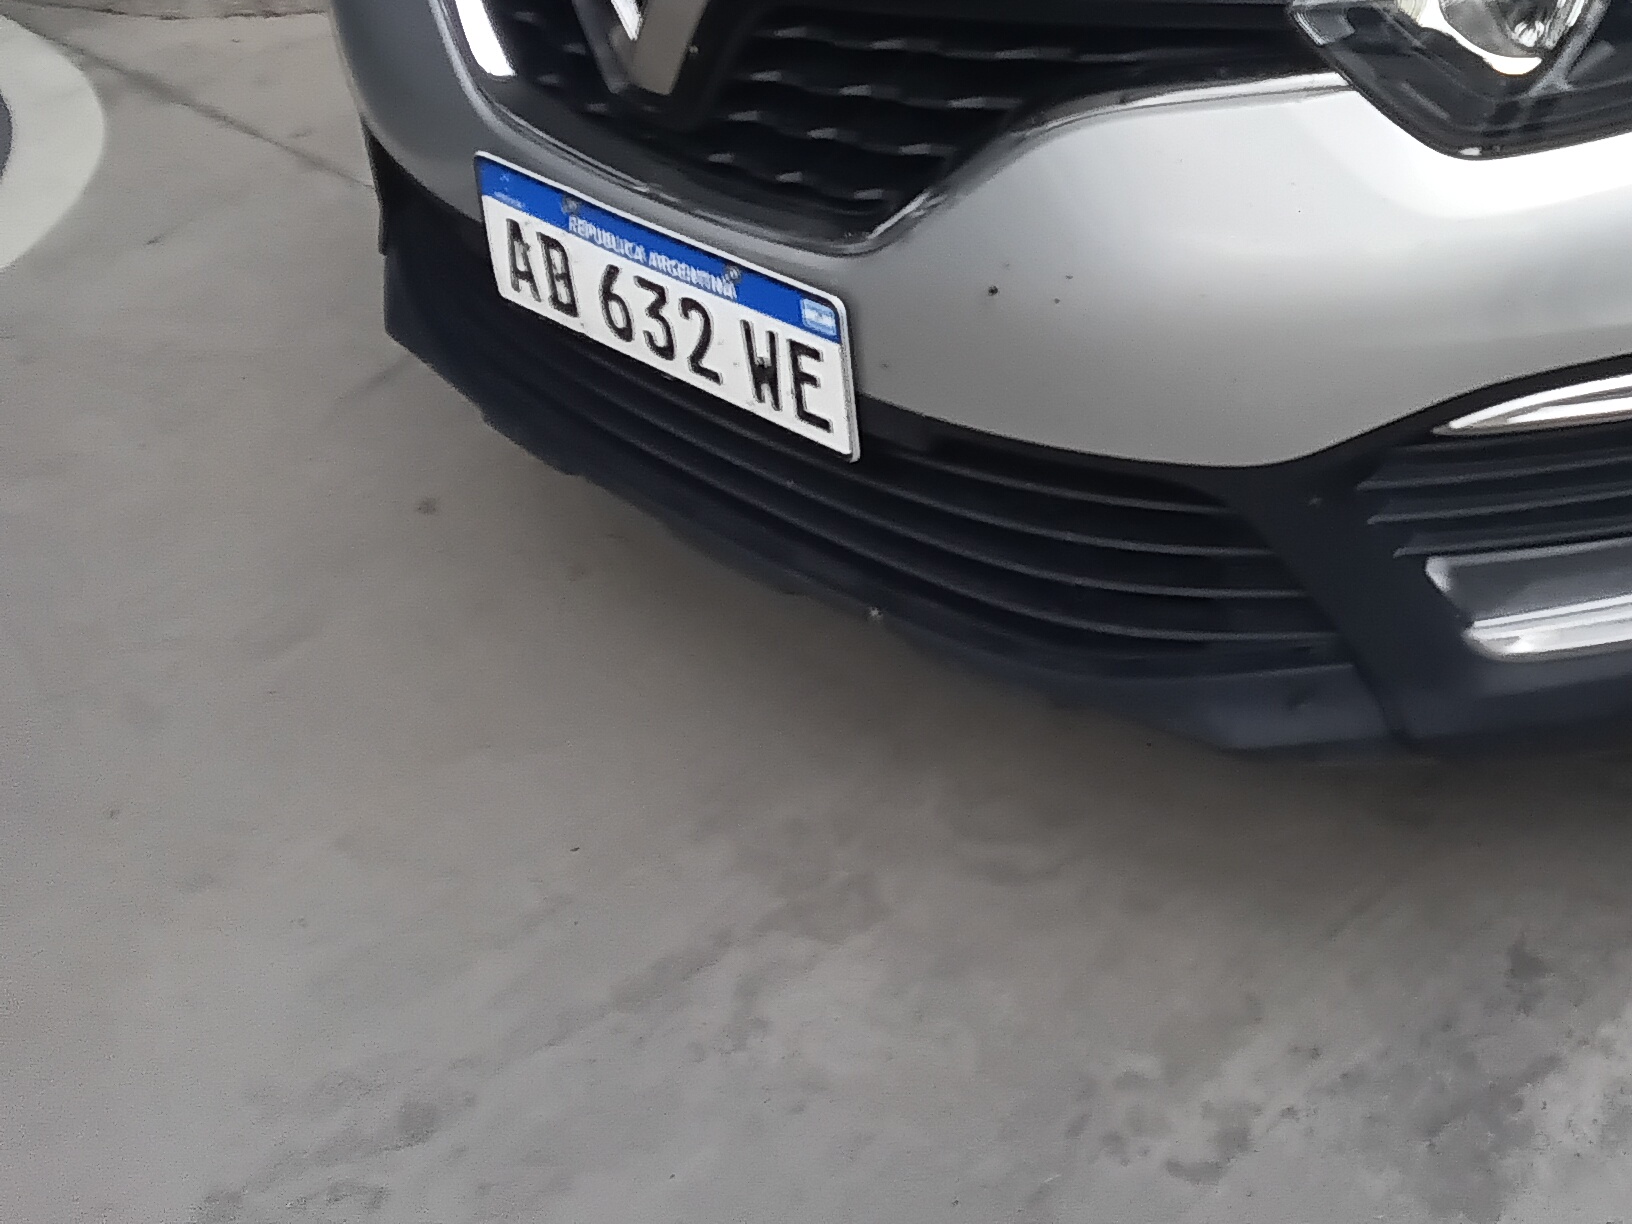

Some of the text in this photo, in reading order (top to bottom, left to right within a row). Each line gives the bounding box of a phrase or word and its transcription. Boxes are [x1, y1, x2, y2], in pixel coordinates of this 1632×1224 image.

[505, 218, 833, 434] AB 632 WE
